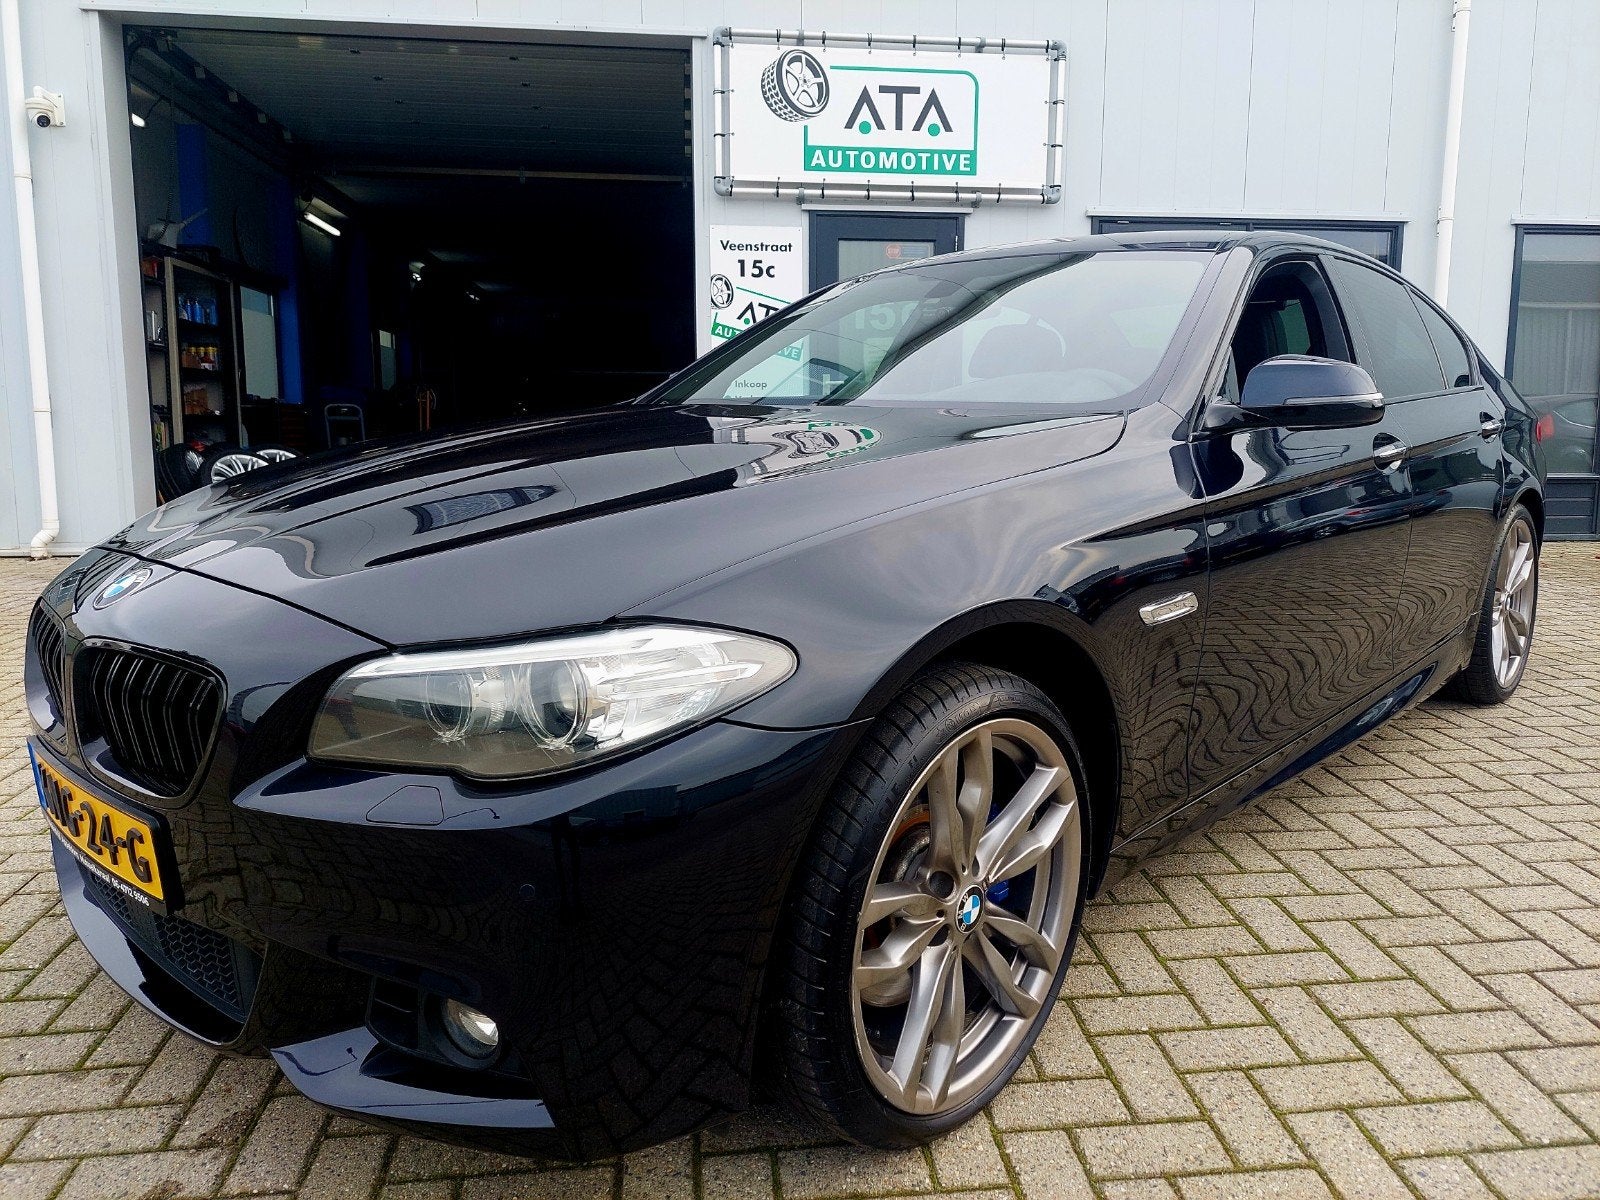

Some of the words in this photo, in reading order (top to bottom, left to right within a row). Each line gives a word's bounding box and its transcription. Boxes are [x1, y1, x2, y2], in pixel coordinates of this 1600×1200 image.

[844, 85, 953, 136] ATA
[810, 149, 971, 172] AUTOMOTIVE
[720, 239, 793, 252] Veenstraat
[737, 258, 776, 279] 15c
[736, 301, 780, 323] AT
[734, 379, 768, 391] Inkoop
